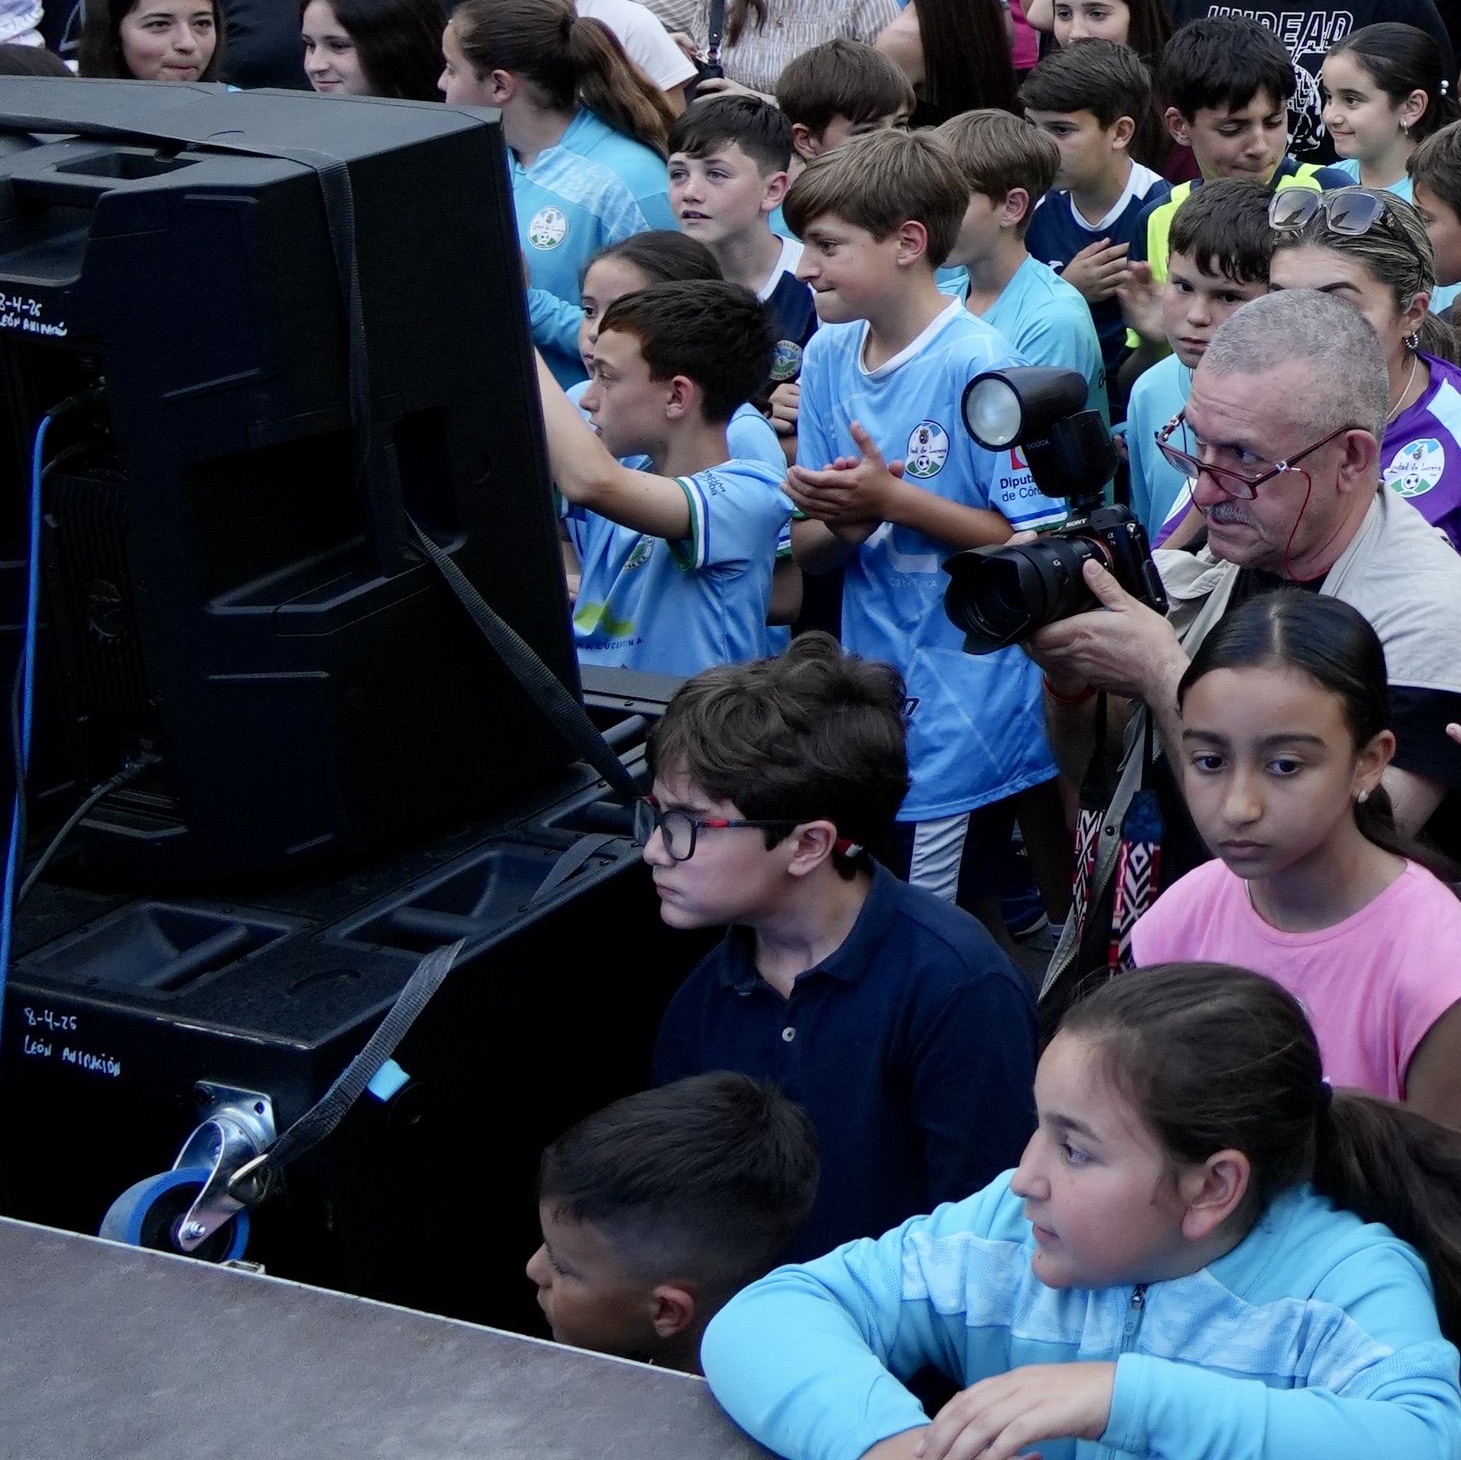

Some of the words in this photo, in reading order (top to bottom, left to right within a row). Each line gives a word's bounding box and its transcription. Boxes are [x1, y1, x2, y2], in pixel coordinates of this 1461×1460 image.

[1000, 475, 1036, 491] Diputa
[1002, 490, 1016, 502] de
[1066, 518, 1087, 529] SONY
